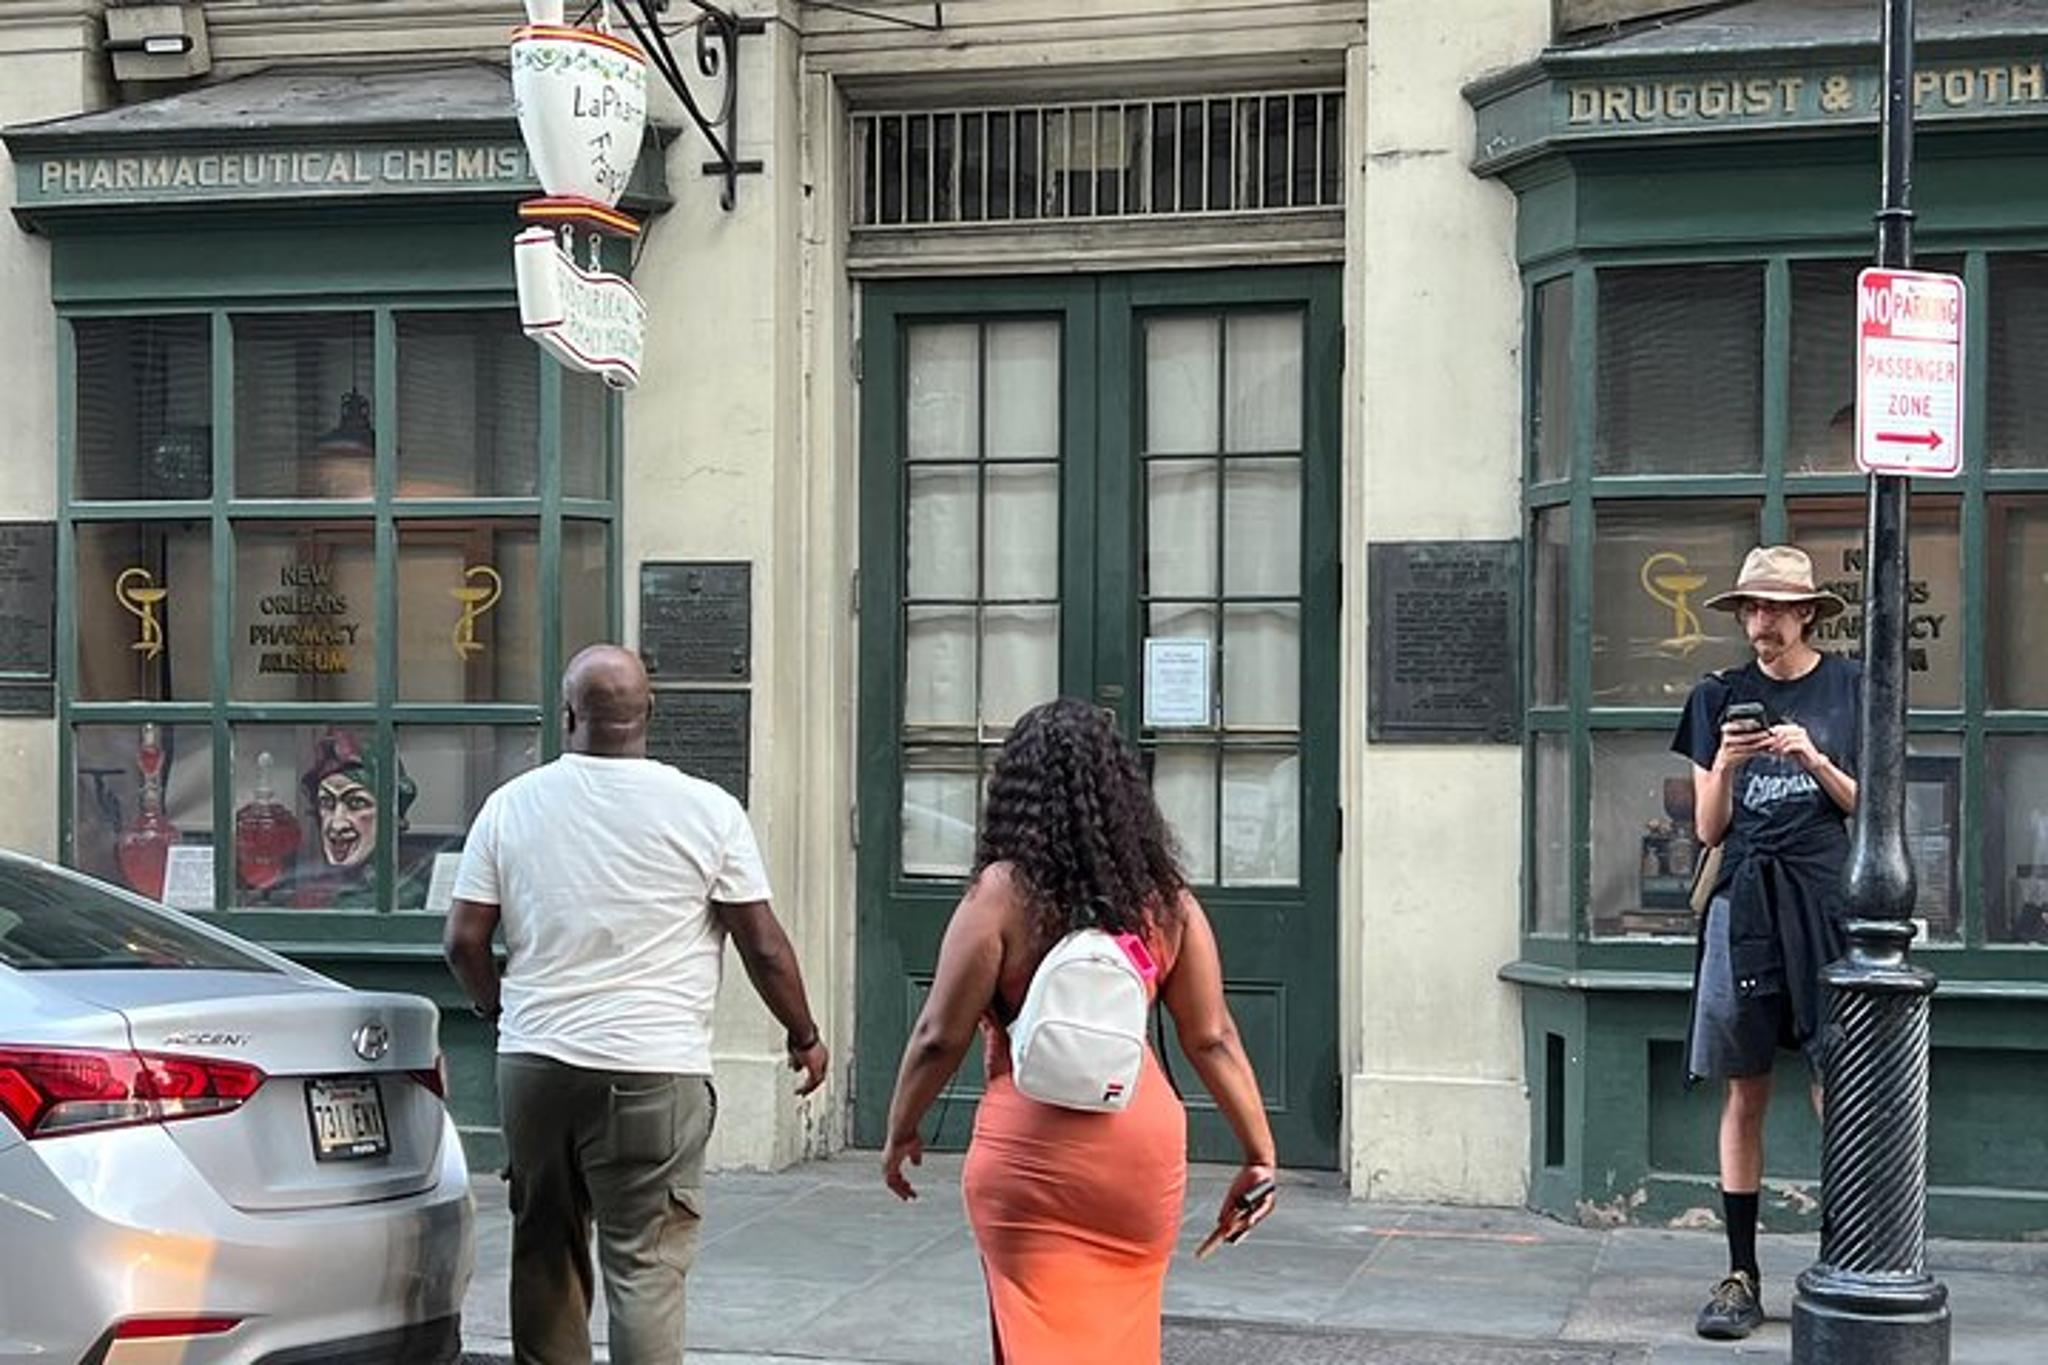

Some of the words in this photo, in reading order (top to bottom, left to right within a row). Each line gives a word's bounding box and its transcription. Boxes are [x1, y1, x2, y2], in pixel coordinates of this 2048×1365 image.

[1569, 78, 1803, 126] DRUGGIST
[1820, 74, 1852, 114] &
[39, 151, 371, 193] PHARMACEUTICAL
[1862, 285, 1892, 325] NO
[1893, 294, 1957, 325] PARKING
[1866, 355, 1955, 382] PASSENGER
[1888, 394, 1932, 418] ZONE
[280, 565, 333, 587] NEW
[259, 595, 347, 616] ORLEANS
[249, 623, 360, 646] PHARMACY
[258, 650, 347, 675] MUSEUM
